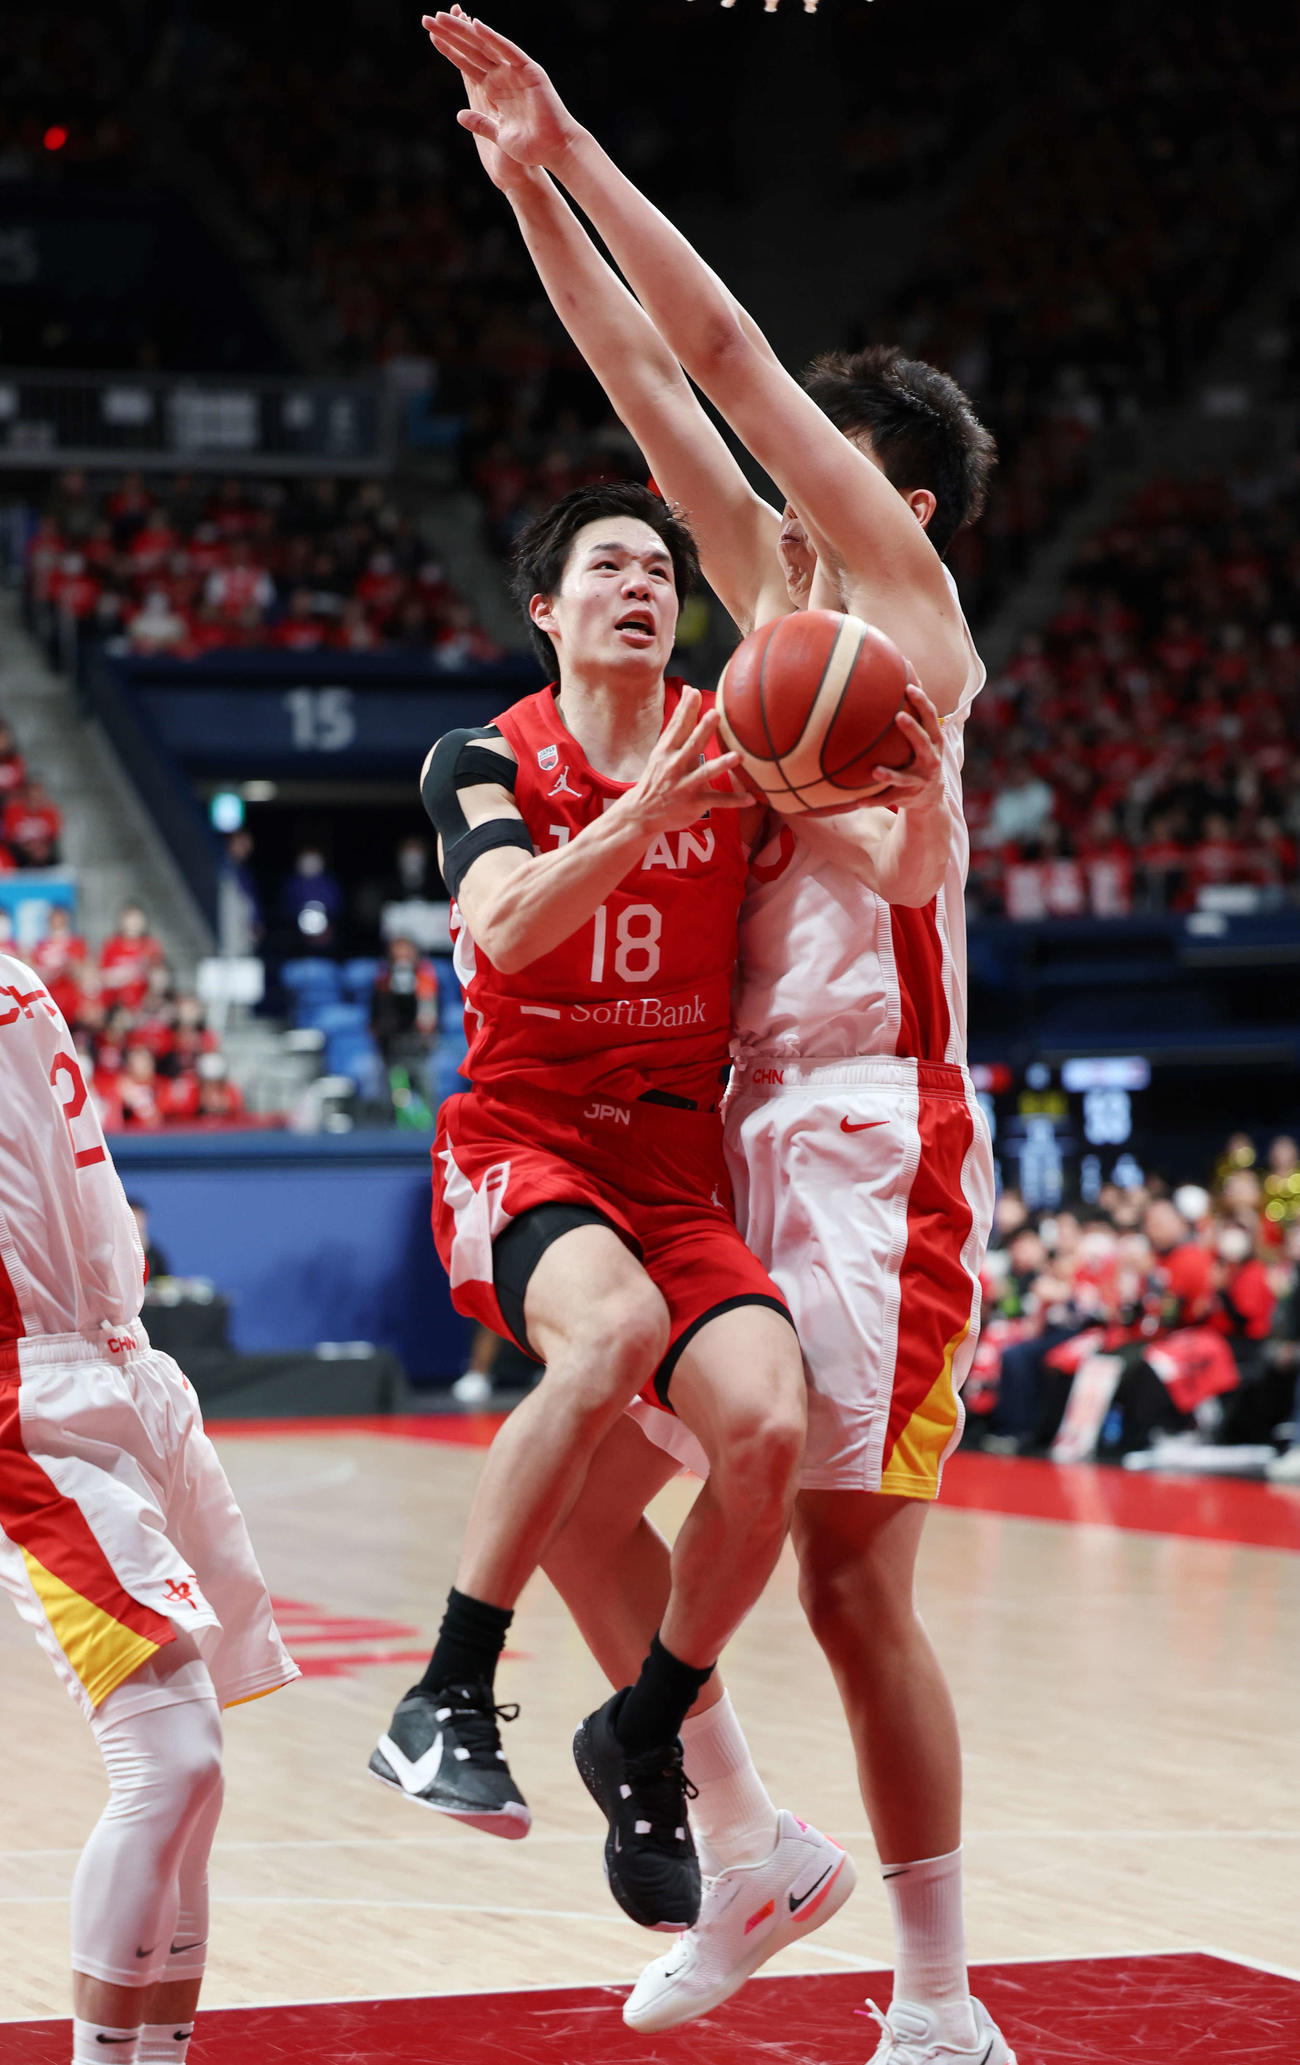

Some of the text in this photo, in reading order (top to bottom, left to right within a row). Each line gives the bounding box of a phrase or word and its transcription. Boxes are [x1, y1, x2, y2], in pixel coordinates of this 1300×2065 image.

[284, 687, 356, 750] 15
[590, 904, 662, 983] 18
[571, 994, 706, 1027] SoftBank
[753, 1068, 784, 1085] CHN
[584, 1103, 630, 1125] JPN
[107, 1336, 136, 1353] CHN
